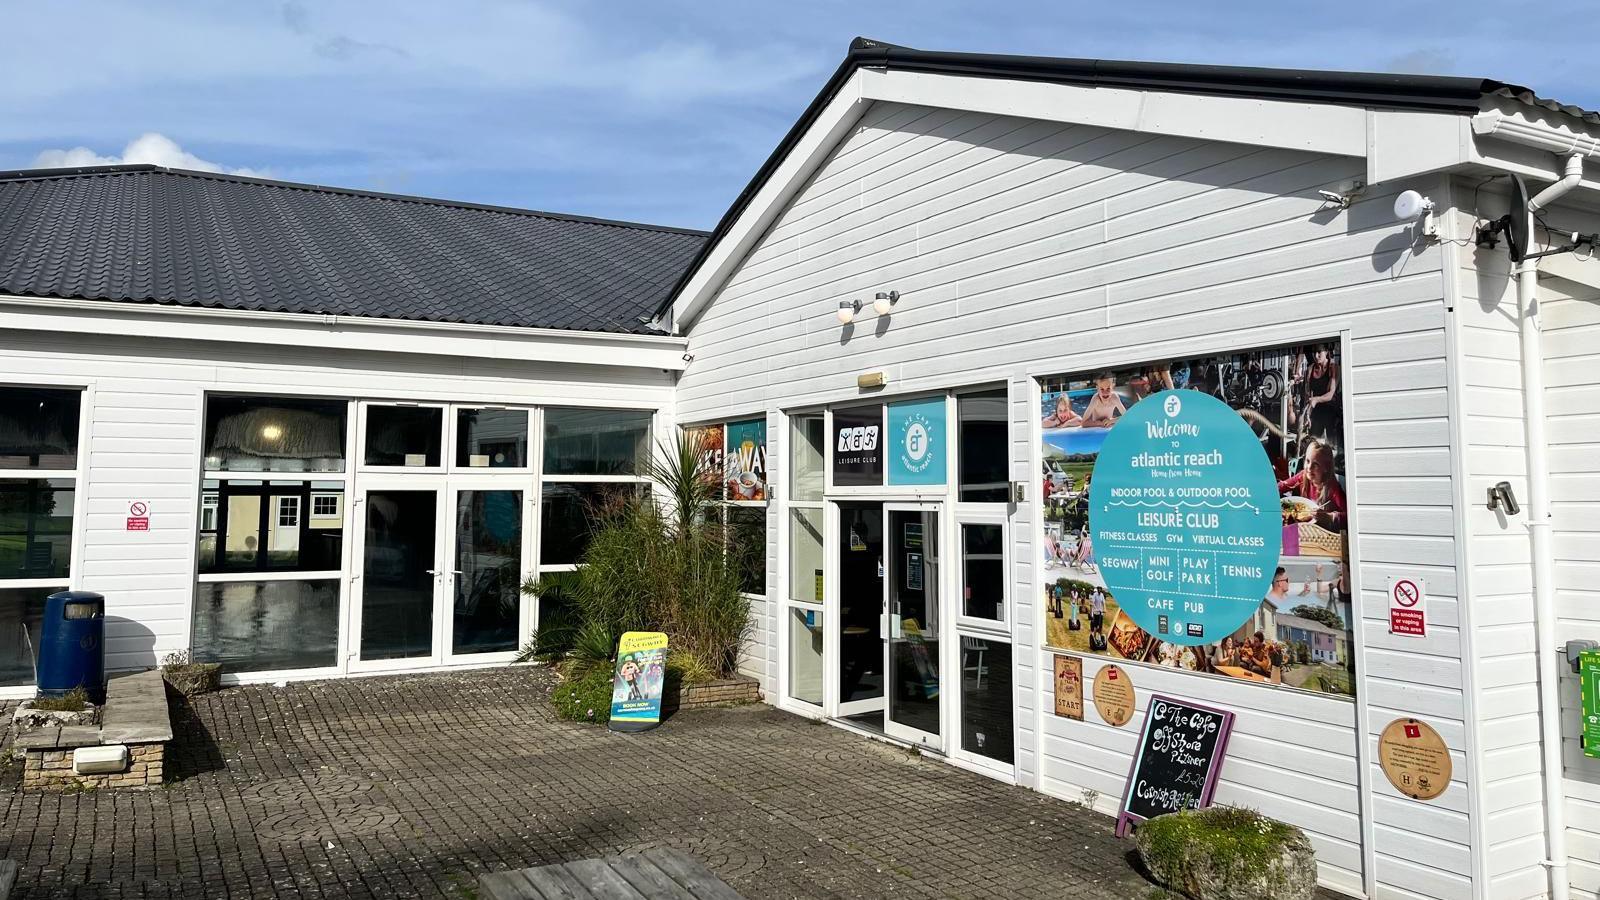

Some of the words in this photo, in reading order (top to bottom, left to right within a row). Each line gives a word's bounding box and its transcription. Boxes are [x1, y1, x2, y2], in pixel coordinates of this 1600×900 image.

[916, 414, 932, 431] CAFE
[1145, 419, 1200, 438] Welcome
[902, 456, 919, 472] atlantic
[920, 452, 932, 471] reach
[1132, 452, 1180, 467] atlantic
[1184, 449, 1222, 466] reach
[1111, 488, 1142, 497] INDOOR
[1144, 488, 1166, 497] POOL
[1168, 488, 1174, 497] &
[1176, 488, 1222, 497] OUTDOOR
[1224, 488, 1251, 497] POOL
[1138, 512, 1182, 527] LEISURE
[1187, 514, 1219, 528] CLUB
[1100, 532, 1125, 540] FITNESS
[1127, 532, 1157, 542] CLASSES
[1166, 534, 1183, 543] GYM
[1192, 535, 1225, 545] VIRTUAL
[1227, 536, 1264, 546] CLASSES
[1102, 558, 1139, 569] SEGWAY
[1150, 556, 1169, 567] MINI
[1183, 558, 1208, 569] PLAY
[1147, 570, 1173, 582] GOLF
[1222, 565, 1262, 578] TENNIS
[1182, 572, 1211, 584] PARK
[1148, 598, 1174, 610] CAFE
[1184, 602, 1204, 613] PUB
[1058, 699, 1080, 710] START
[1168, 706, 1188, 727] The
[1190, 713, 1216, 740] Cafe
[1403, 775, 1410, 784] H
[1138, 780, 1169, 809] Cornish
